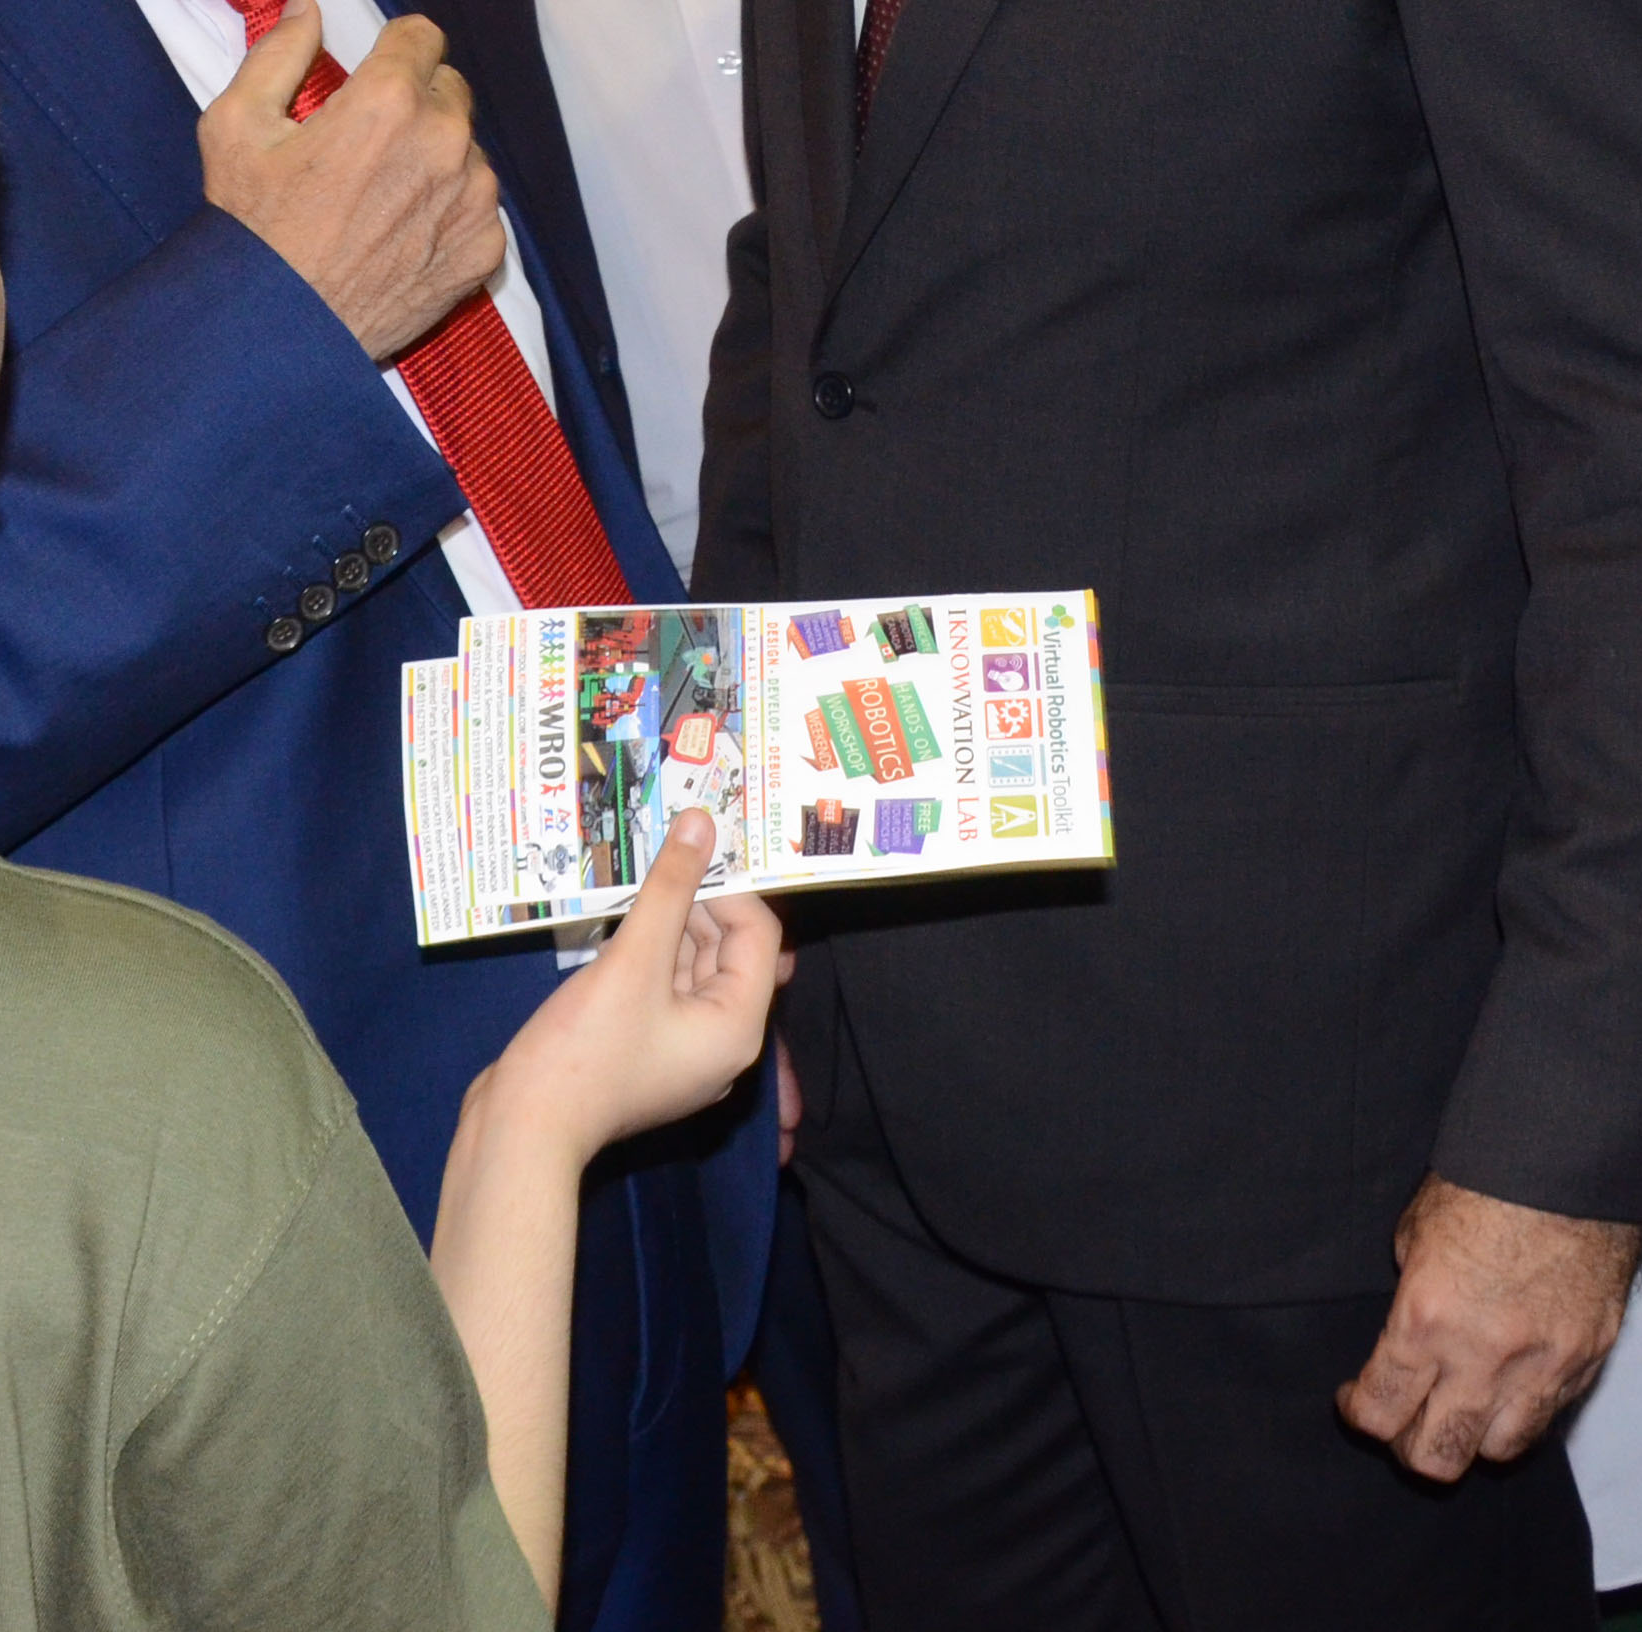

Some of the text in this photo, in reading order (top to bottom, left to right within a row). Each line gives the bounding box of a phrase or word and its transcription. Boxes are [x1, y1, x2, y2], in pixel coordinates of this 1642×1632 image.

[539, 701, 566, 779] WRO
[767, 622, 782, 854] DESIGN DEVELOP DEBUG DEPLOY
[807, 711, 834, 771] WEEKENDS
[826, 695, 866, 772] WORKSHOP
[855, 678, 905, 781] ROBOTICS
[893, 683, 934, 761] HANDS ON
[1043, 630, 1074, 835] Virtual Robotics Toolkit
[475, 830, 484, 847] ARE
[498, 808, 507, 837] Levels
[544, 808, 554, 832] FLL
[823, 799, 835, 822] FREE
[917, 802, 931, 832] FREE
[488, 854, 498, 893] CANADA
